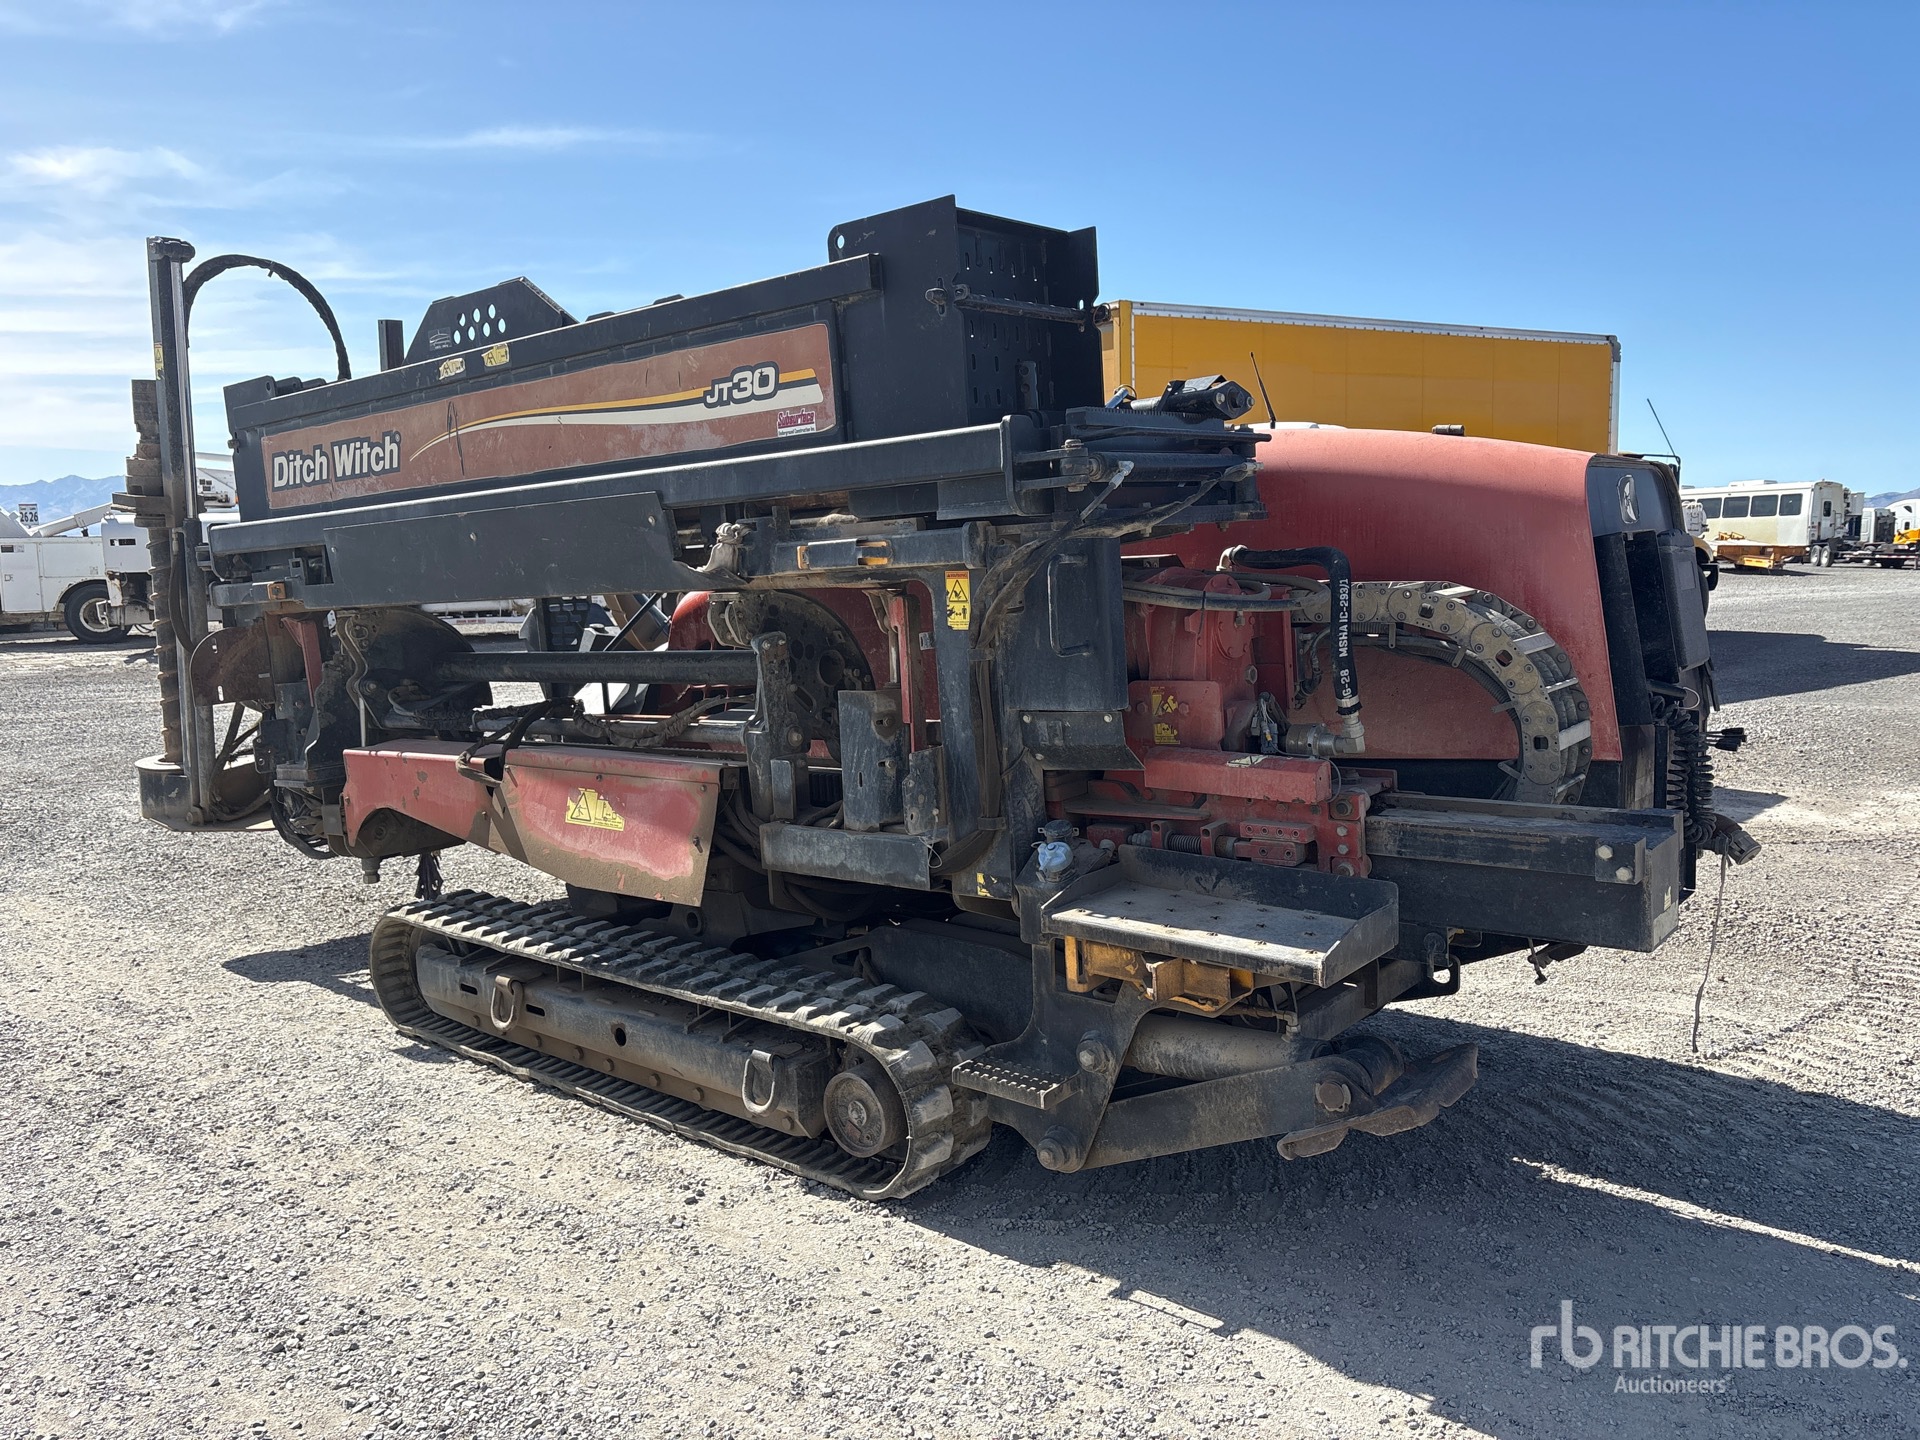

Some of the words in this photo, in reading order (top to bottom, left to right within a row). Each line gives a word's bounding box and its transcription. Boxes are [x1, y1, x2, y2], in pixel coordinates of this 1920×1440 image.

[706, 366, 776, 404] JT30
[273, 448, 328, 488] Ditch
[333, 435, 398, 478] Witch
[1339, 578, 1350, 623] IC-293/1
[1339, 624, 1349, 657] MSHA
